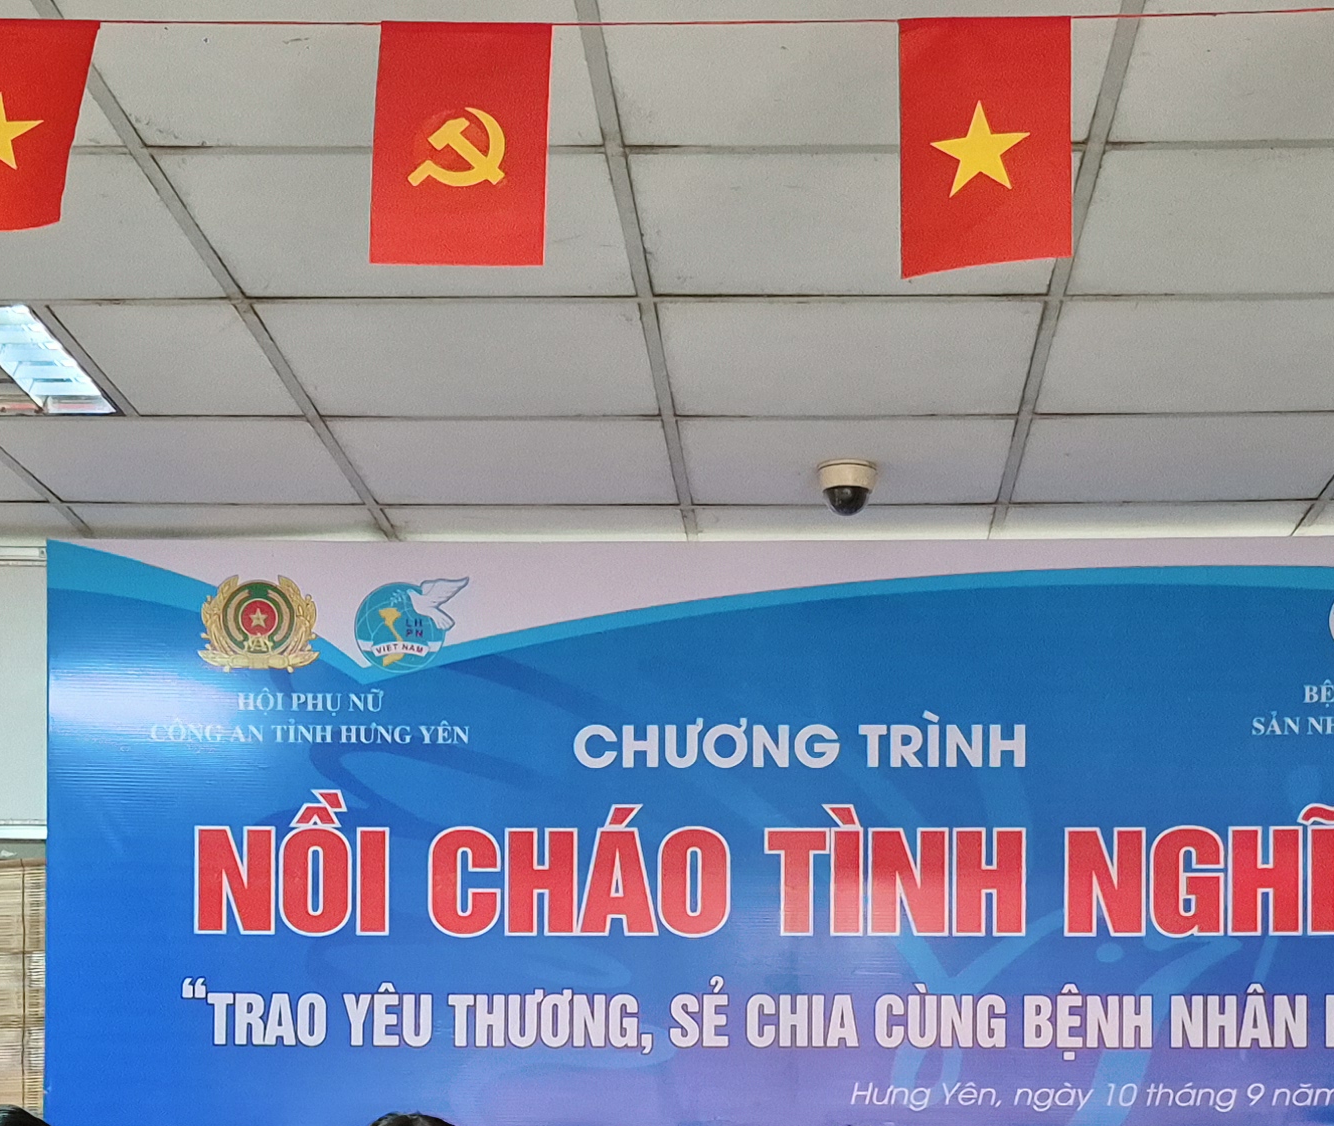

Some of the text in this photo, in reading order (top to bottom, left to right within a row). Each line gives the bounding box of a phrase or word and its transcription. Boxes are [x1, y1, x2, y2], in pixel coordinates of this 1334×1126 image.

[401, 643, 424, 654] NAM
[237, 687, 384, 717] HỘI PHỤ NỮ
[149, 718, 470, 745] CÔNG AN TỈNH HƯNG YÊN
[1251, 710, 1300, 736] SẢN
[573, 710, 1027, 769] CHƯƠNG TRÌNH
[193, 789, 390, 936] NỒI
[427, 803, 731, 937] CHÁO
[764, 803, 1027, 937] TÌNH
[180, 977, 328, 1048] “TRAO
[343, 982, 433, 1048] YÊU
[447, 988, 655, 1054] THƯƠNG,
[669, 975, 728, 1048] SẺ
[745, 993, 860, 1048] CHIA
[874, 981, 1007, 1049] CÙNG
[1023, 984, 1153, 1060] BỆNH
[1170, 983, 1309, 1048] NHÂN
[849, 1082, 932, 1112] Hưng
[941, 1082, 1003, 1108] Yên,
[1013, 1082, 1095, 1112] ngày
[1105, 1083, 1139, 1107] 10
[1145, 1081, 1238, 1113] tháng
[1245, 1083, 1266, 1107] 9
